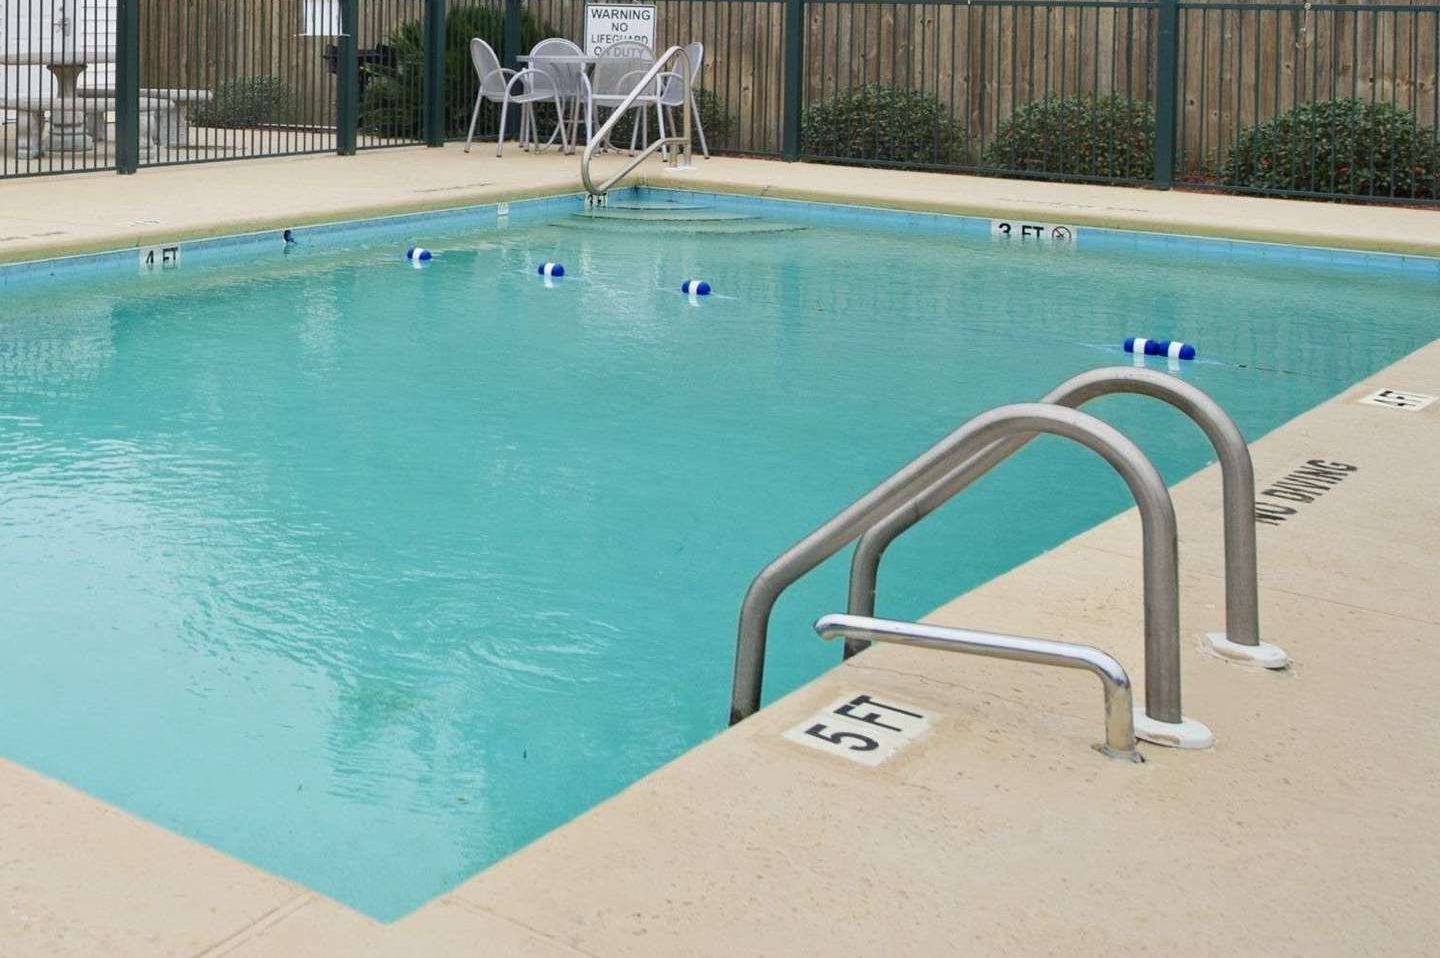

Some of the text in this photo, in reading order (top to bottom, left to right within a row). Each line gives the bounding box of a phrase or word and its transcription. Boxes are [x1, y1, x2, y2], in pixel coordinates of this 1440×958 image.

[591, 9, 651, 20] WARNING
[611, 22, 628, 32] NO
[1021, 225, 1045, 241] FT
[1261, 459, 1358, 504] DIVING
[804, 695, 923, 751] 5 FT
